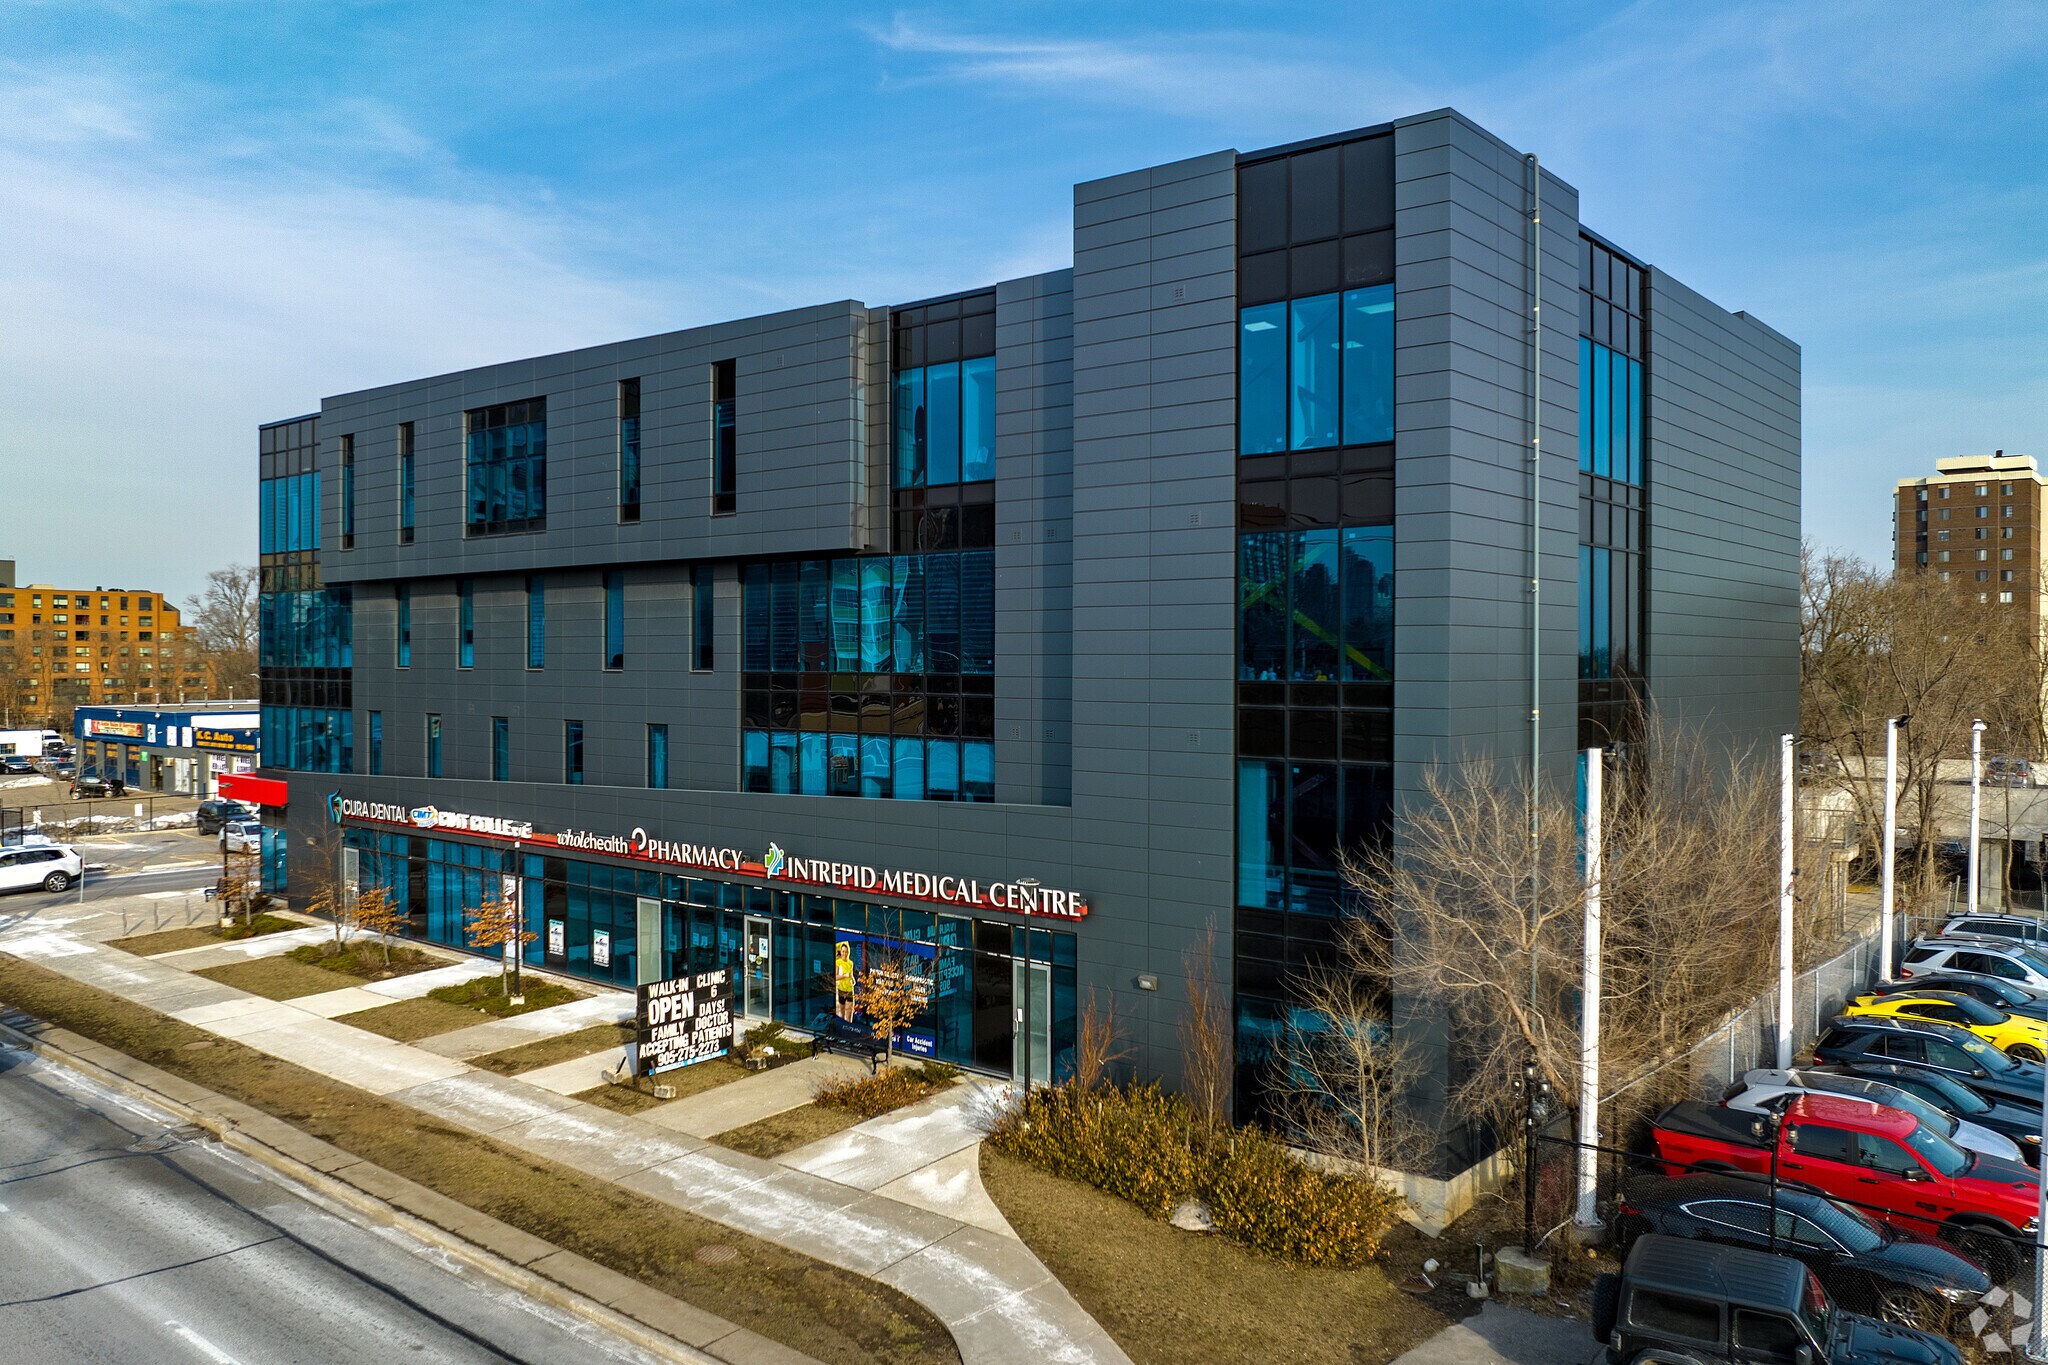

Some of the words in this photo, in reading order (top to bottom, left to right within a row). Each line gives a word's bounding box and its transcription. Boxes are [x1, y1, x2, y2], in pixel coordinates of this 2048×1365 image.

[196, 730, 212, 740] K.C.
[213, 732, 234, 742] Auto
[343, 799, 368, 818] CURA
[370, 803, 408, 823] DENTAL
[557, 829, 628, 854] wholehealth
[648, 839, 743, 870] PHARMACY
[787, 856, 876, 888] INTREPID
[883, 869, 982, 904] MEDICAL
[989, 882, 1082, 917] CENTRE
[649, 977, 689, 998] WALK-IN
[696, 970, 725, 988] CLINIC
[710, 985, 717, 997] 6
[648, 991, 694, 1025] OPEN
[699, 999, 725, 1017] DAYS!
[651, 1021, 685, 1041] FAMILY
[695, 1011, 729, 1031] DOCTOR
[906, 1035, 914, 1043] Car
[639, 1033, 689, 1058] ACCEPTING
[691, 1023, 732, 1045] PATIENTS
[658, 1039, 719, 1067] 905-275-2273
